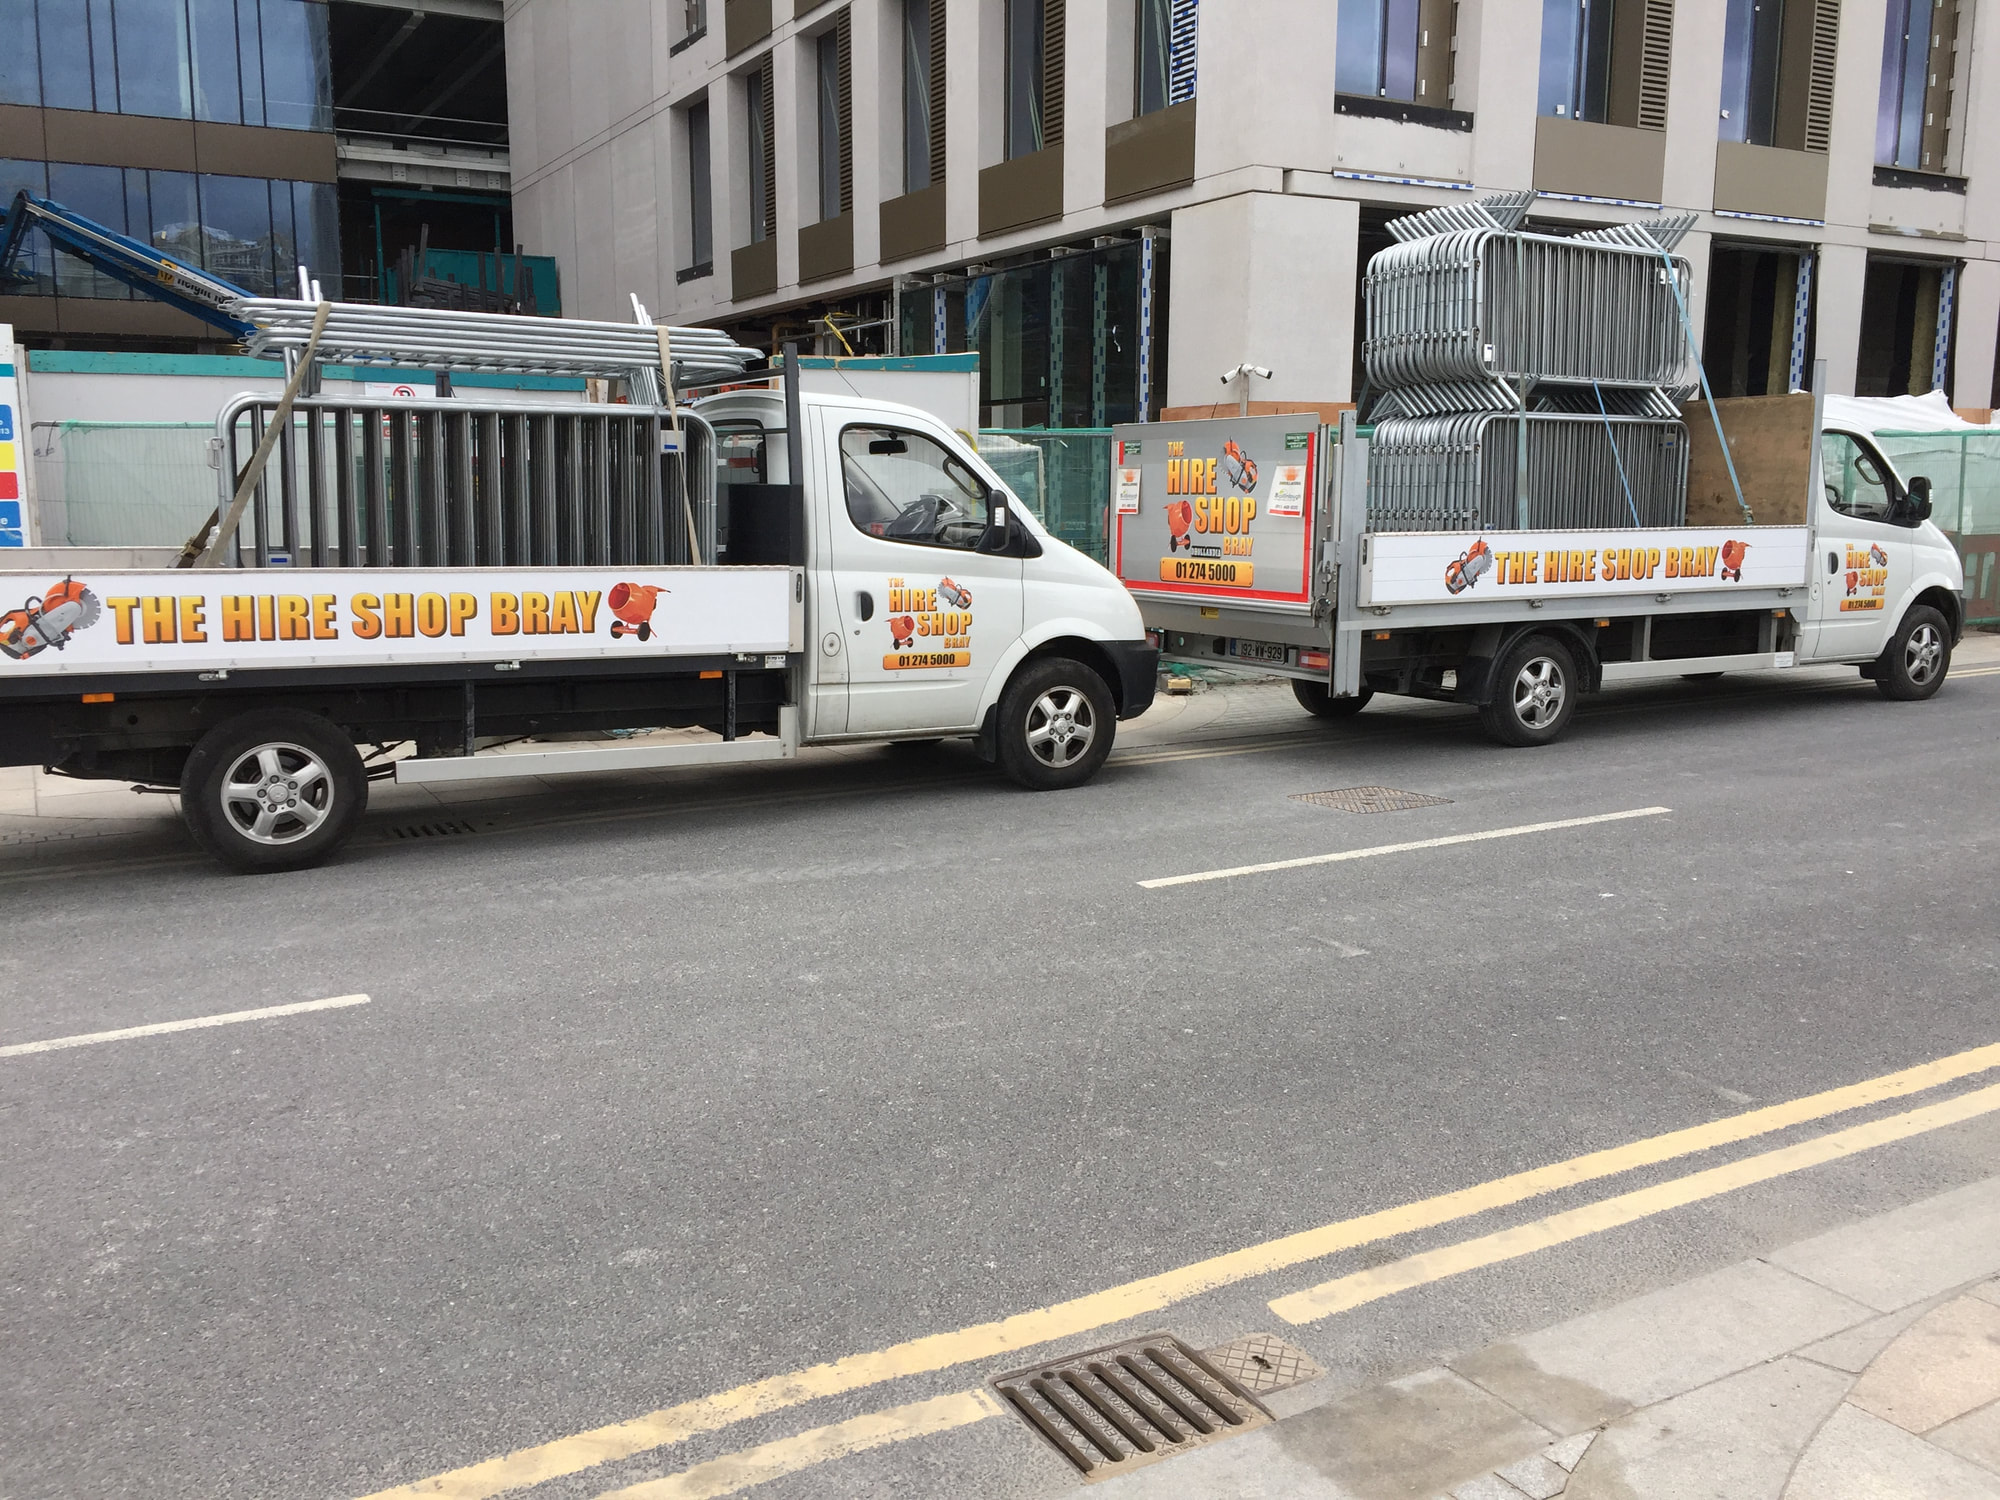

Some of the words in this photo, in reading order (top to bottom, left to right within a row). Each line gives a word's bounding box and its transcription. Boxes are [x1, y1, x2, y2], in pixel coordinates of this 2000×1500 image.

[1167, 441, 1184, 457] THE
[1167, 457, 1217, 495] HIRE
[1194, 497, 1256, 534] SHOP
[1223, 536, 1254, 556] BRAY
[1495, 551, 1538, 584] THE
[1544, 549, 1596, 583] HIRE
[1602, 547, 1661, 580] SHOP
[1665, 545, 1719, 578] BRAY
[1846, 552, 1870, 569] HIRE
[1176, 562, 1187, 578] 01
[1189, 563, 1206, 580] 274
[1209, 564, 1236, 582] 5000
[1859, 569, 1888, 587] SHOP
[888, 577, 905, 588] THE
[889, 588, 937, 612] HIRE
[106, 595, 208, 644] THE
[221, 594, 339, 642] HIRE
[351, 592, 478, 638] SHOP
[490, 590, 602, 635] BRAY
[917, 612, 972, 636] SHOP
[944, 636, 971, 648] BRAY
[899, 655, 910, 667] 01
[912, 654, 928, 666] 274
[930, 653, 955, 665] 5000
